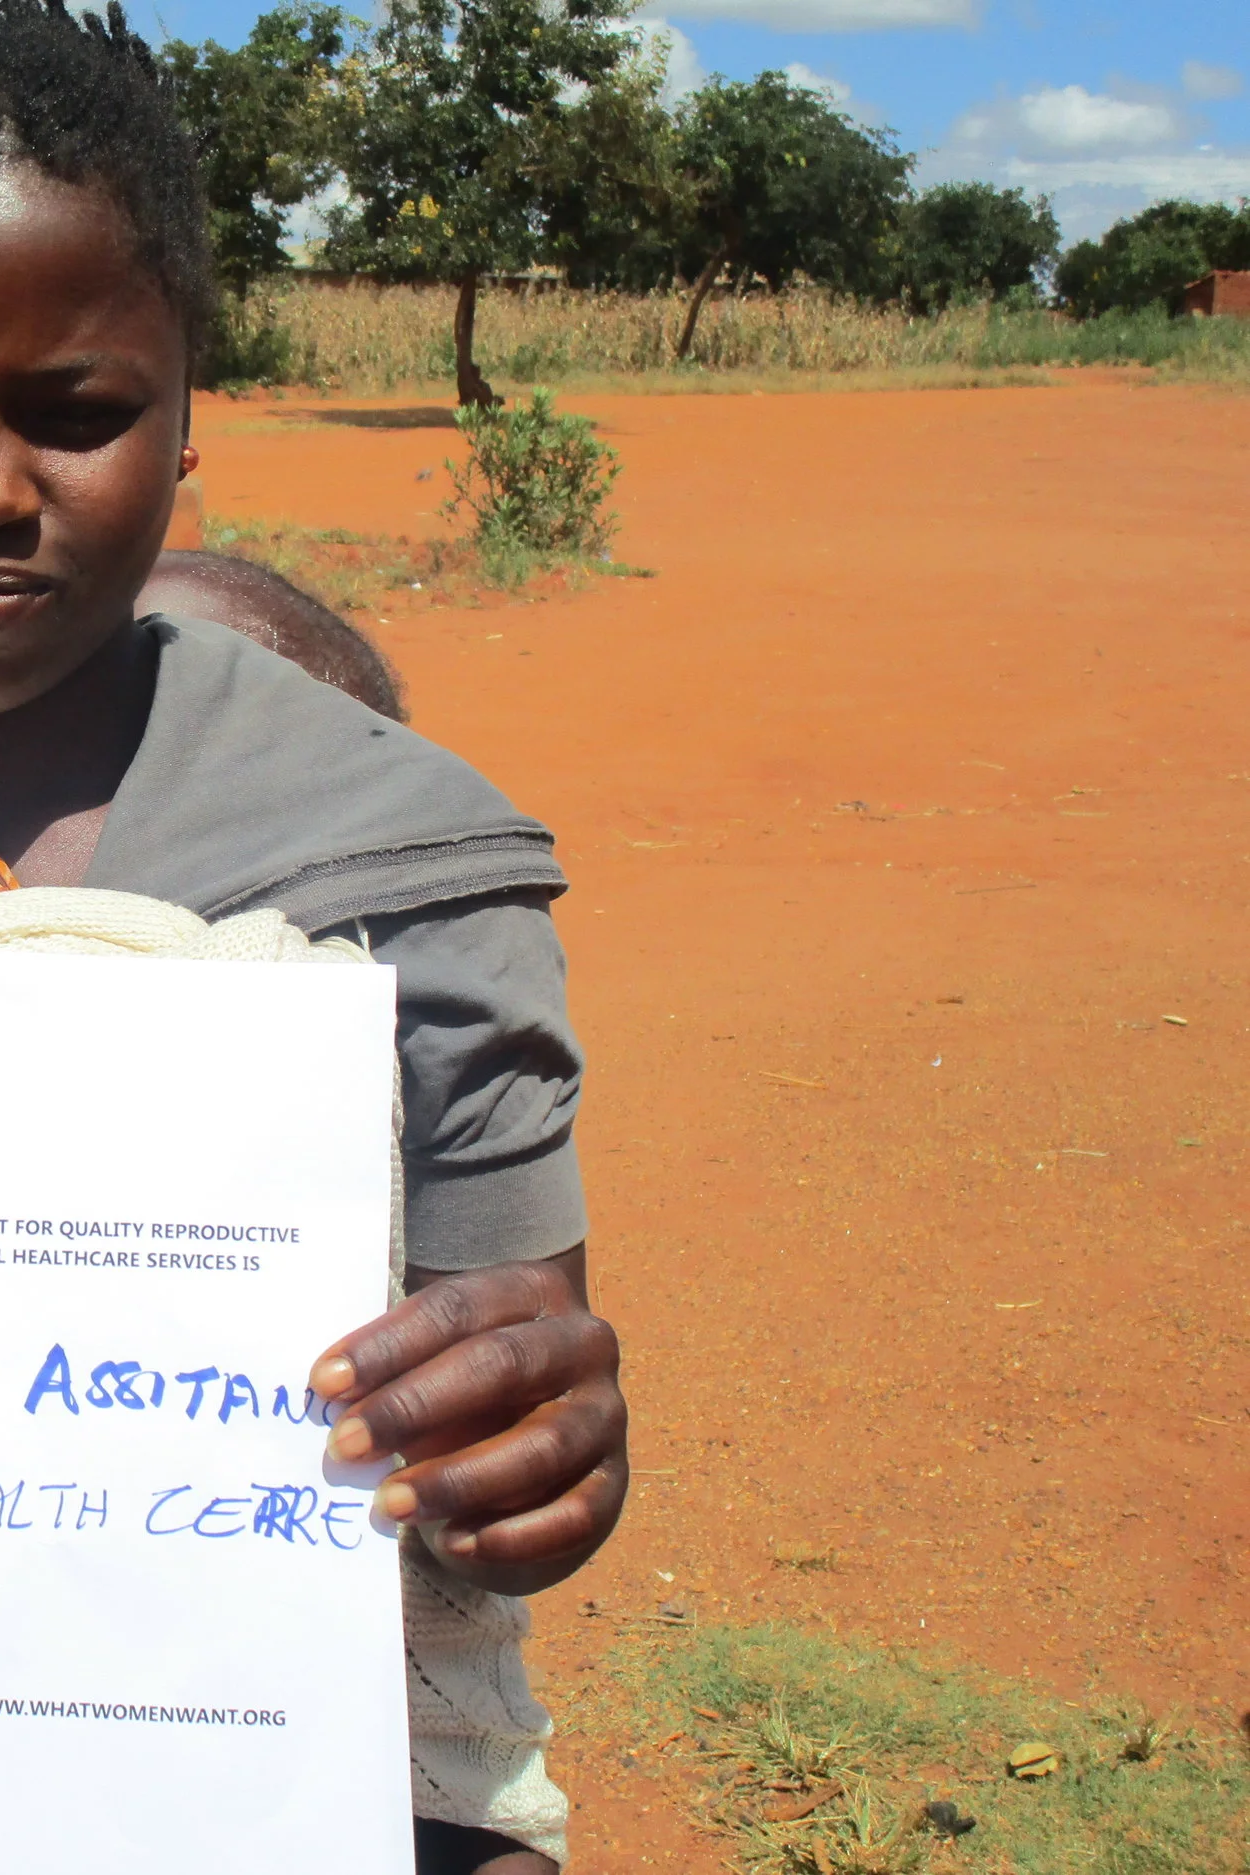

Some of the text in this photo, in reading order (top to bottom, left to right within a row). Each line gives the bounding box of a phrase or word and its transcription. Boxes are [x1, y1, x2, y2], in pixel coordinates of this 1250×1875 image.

[16, 1219, 54, 1236] FOR
[59, 1220, 144, 1240] QUALITY
[151, 1223, 300, 1244] REPRODUCTIVE
[12, 1249, 140, 1268] HEALTHCARE
[146, 1252, 237, 1271] SERVICES
[243, 1255, 260, 1272] IS
